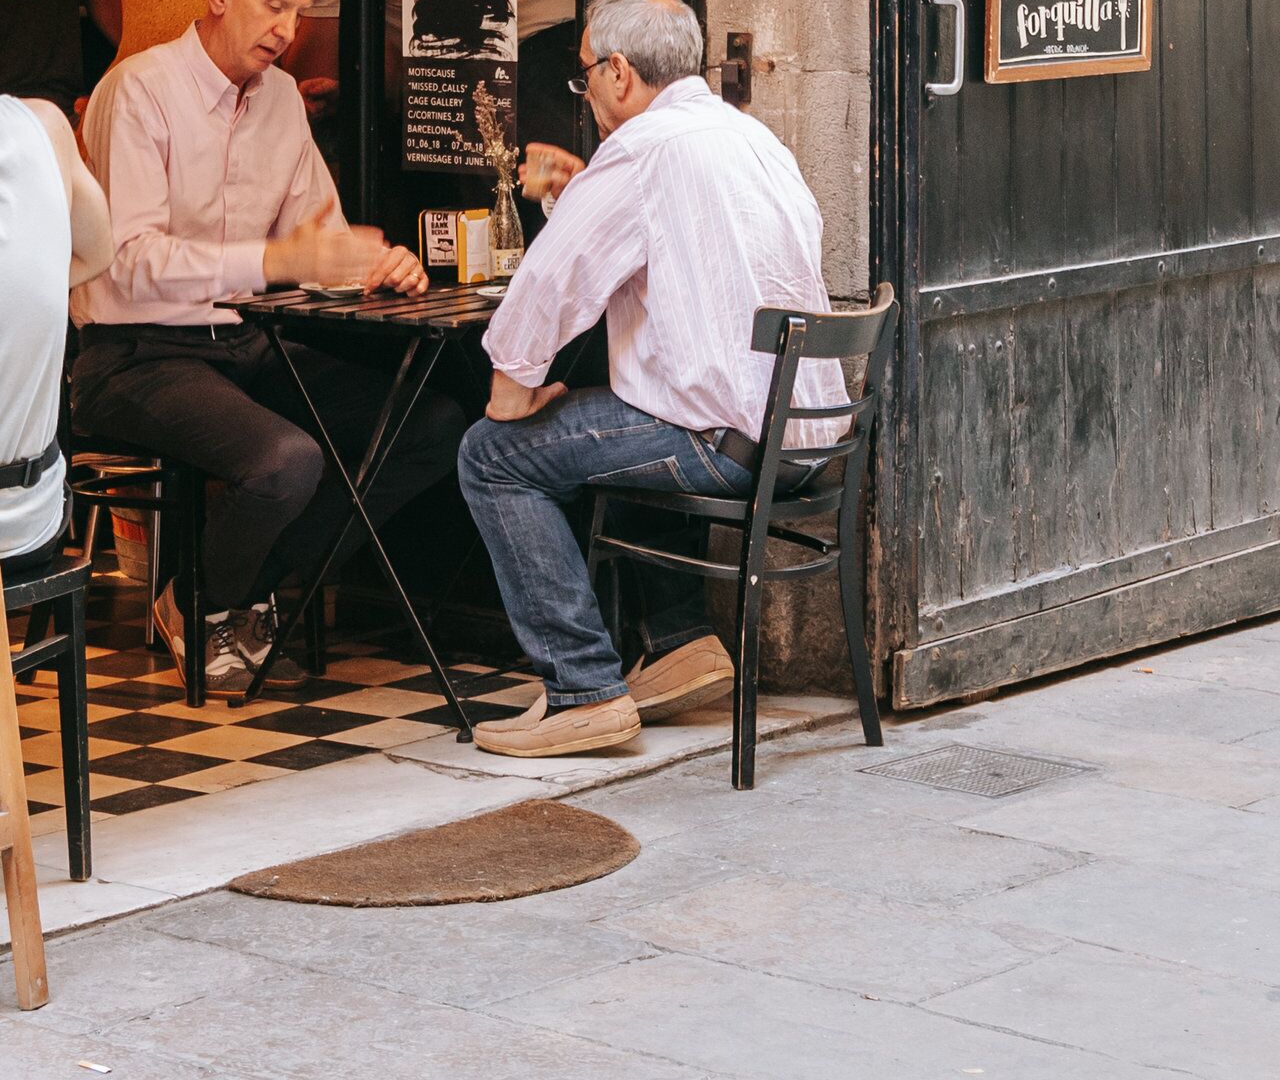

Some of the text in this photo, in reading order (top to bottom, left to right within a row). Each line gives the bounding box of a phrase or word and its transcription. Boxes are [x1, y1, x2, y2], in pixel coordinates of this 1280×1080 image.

[408, 68, 456, 78] MOTISCAUSE
[408, 96, 463, 107] CAGE GALLERY
[407, 124, 452, 135] BARCELONA
[407, 138, 440, 149] 01_06_18
[406, 153, 452, 164] VERNISSAGE
[454, 156, 462, 164] 01
[465, 157, 485, 166] JUNE
